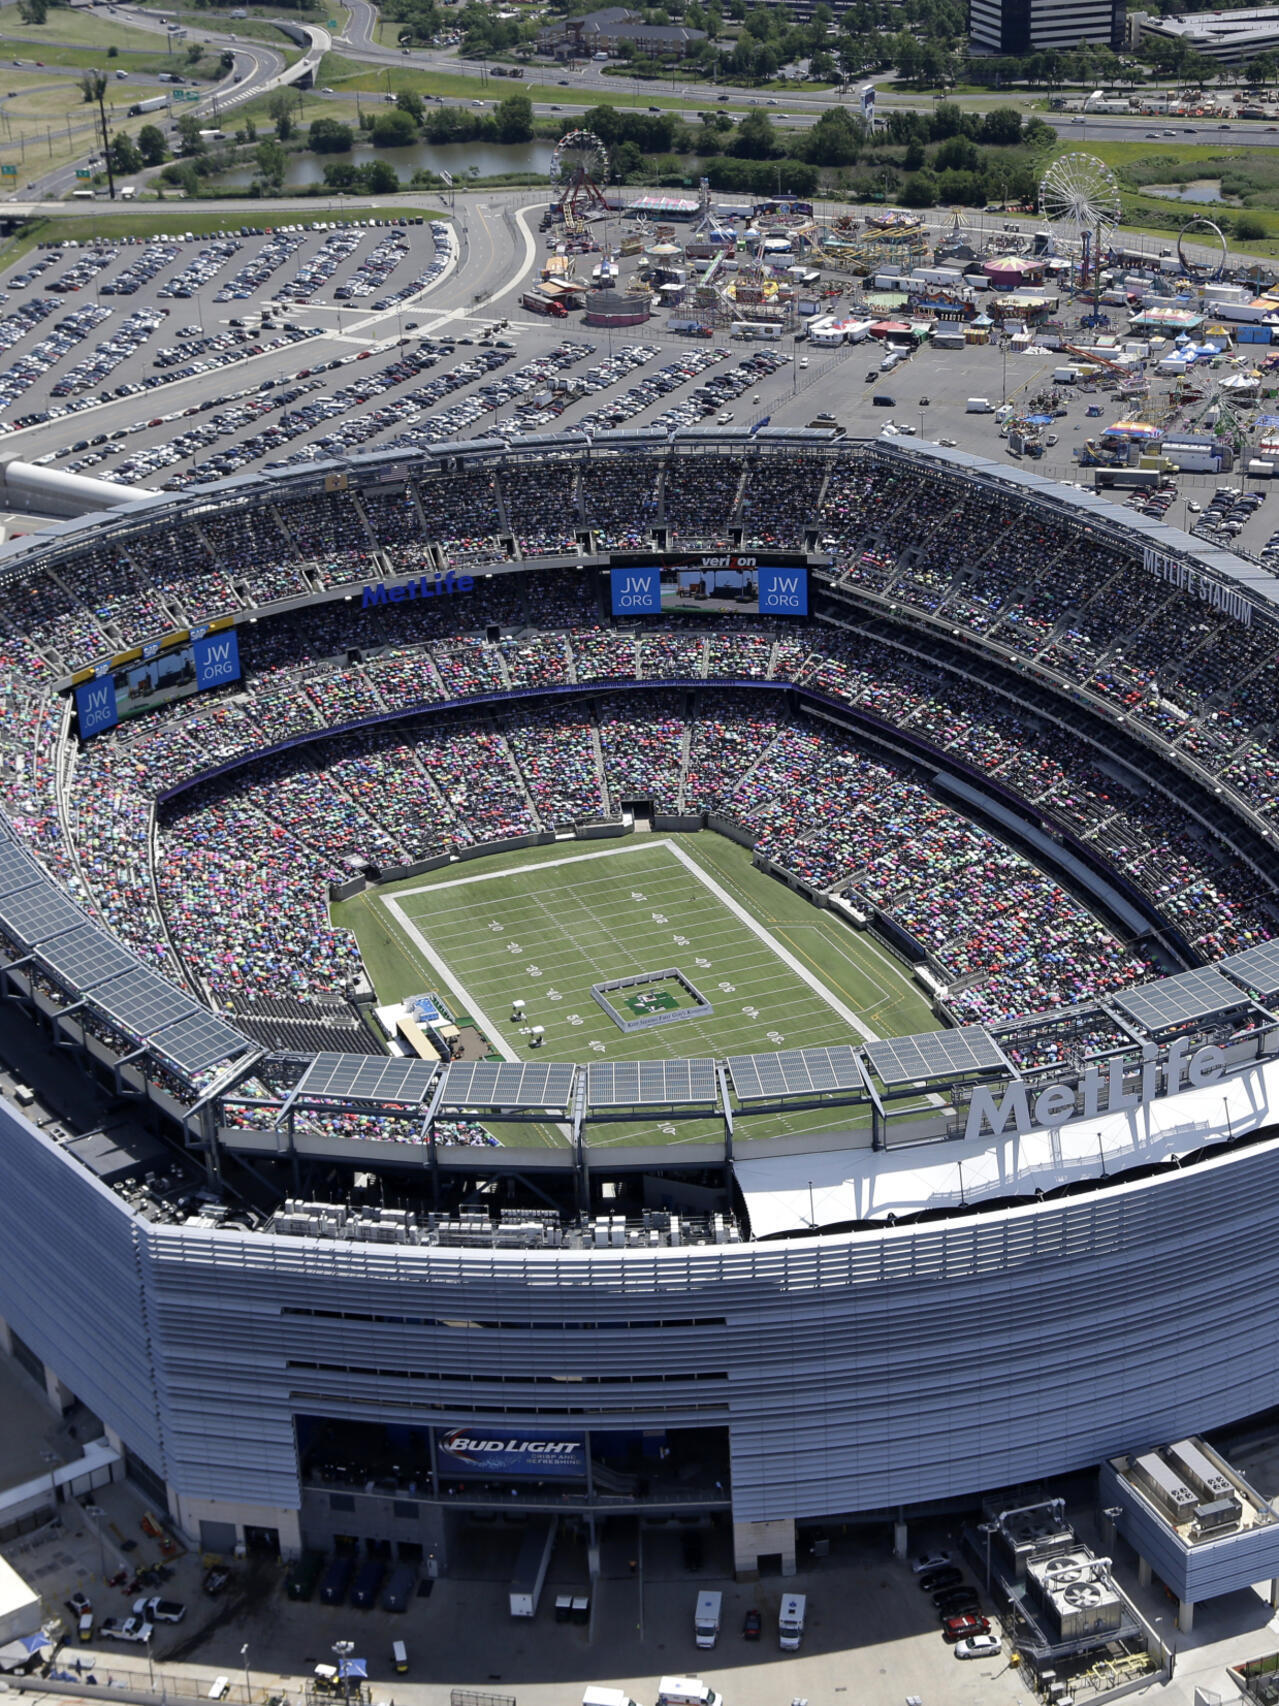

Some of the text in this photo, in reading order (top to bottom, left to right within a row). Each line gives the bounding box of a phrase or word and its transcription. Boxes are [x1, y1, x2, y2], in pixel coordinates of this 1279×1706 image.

[702, 555, 756, 567] verizon
[362, 569, 474, 608] MetLife
[620, 577, 652, 593] JW
[768, 577, 799, 593] JW
[1143, 547, 1252, 629] METLIFE STADIUM
[618, 595, 653, 607] .ORG
[764, 595, 799, 607] .ORG
[203, 642, 230, 666] JW
[202, 661, 233, 681] .ORG
[85, 687, 108, 713] JW
[84, 706, 111, 729] .ORG
[964, 1036, 1225, 1144] MetLife
[657, 1122, 676, 1134] 10
[450, 1438, 581, 1453] BUD LIGHT
